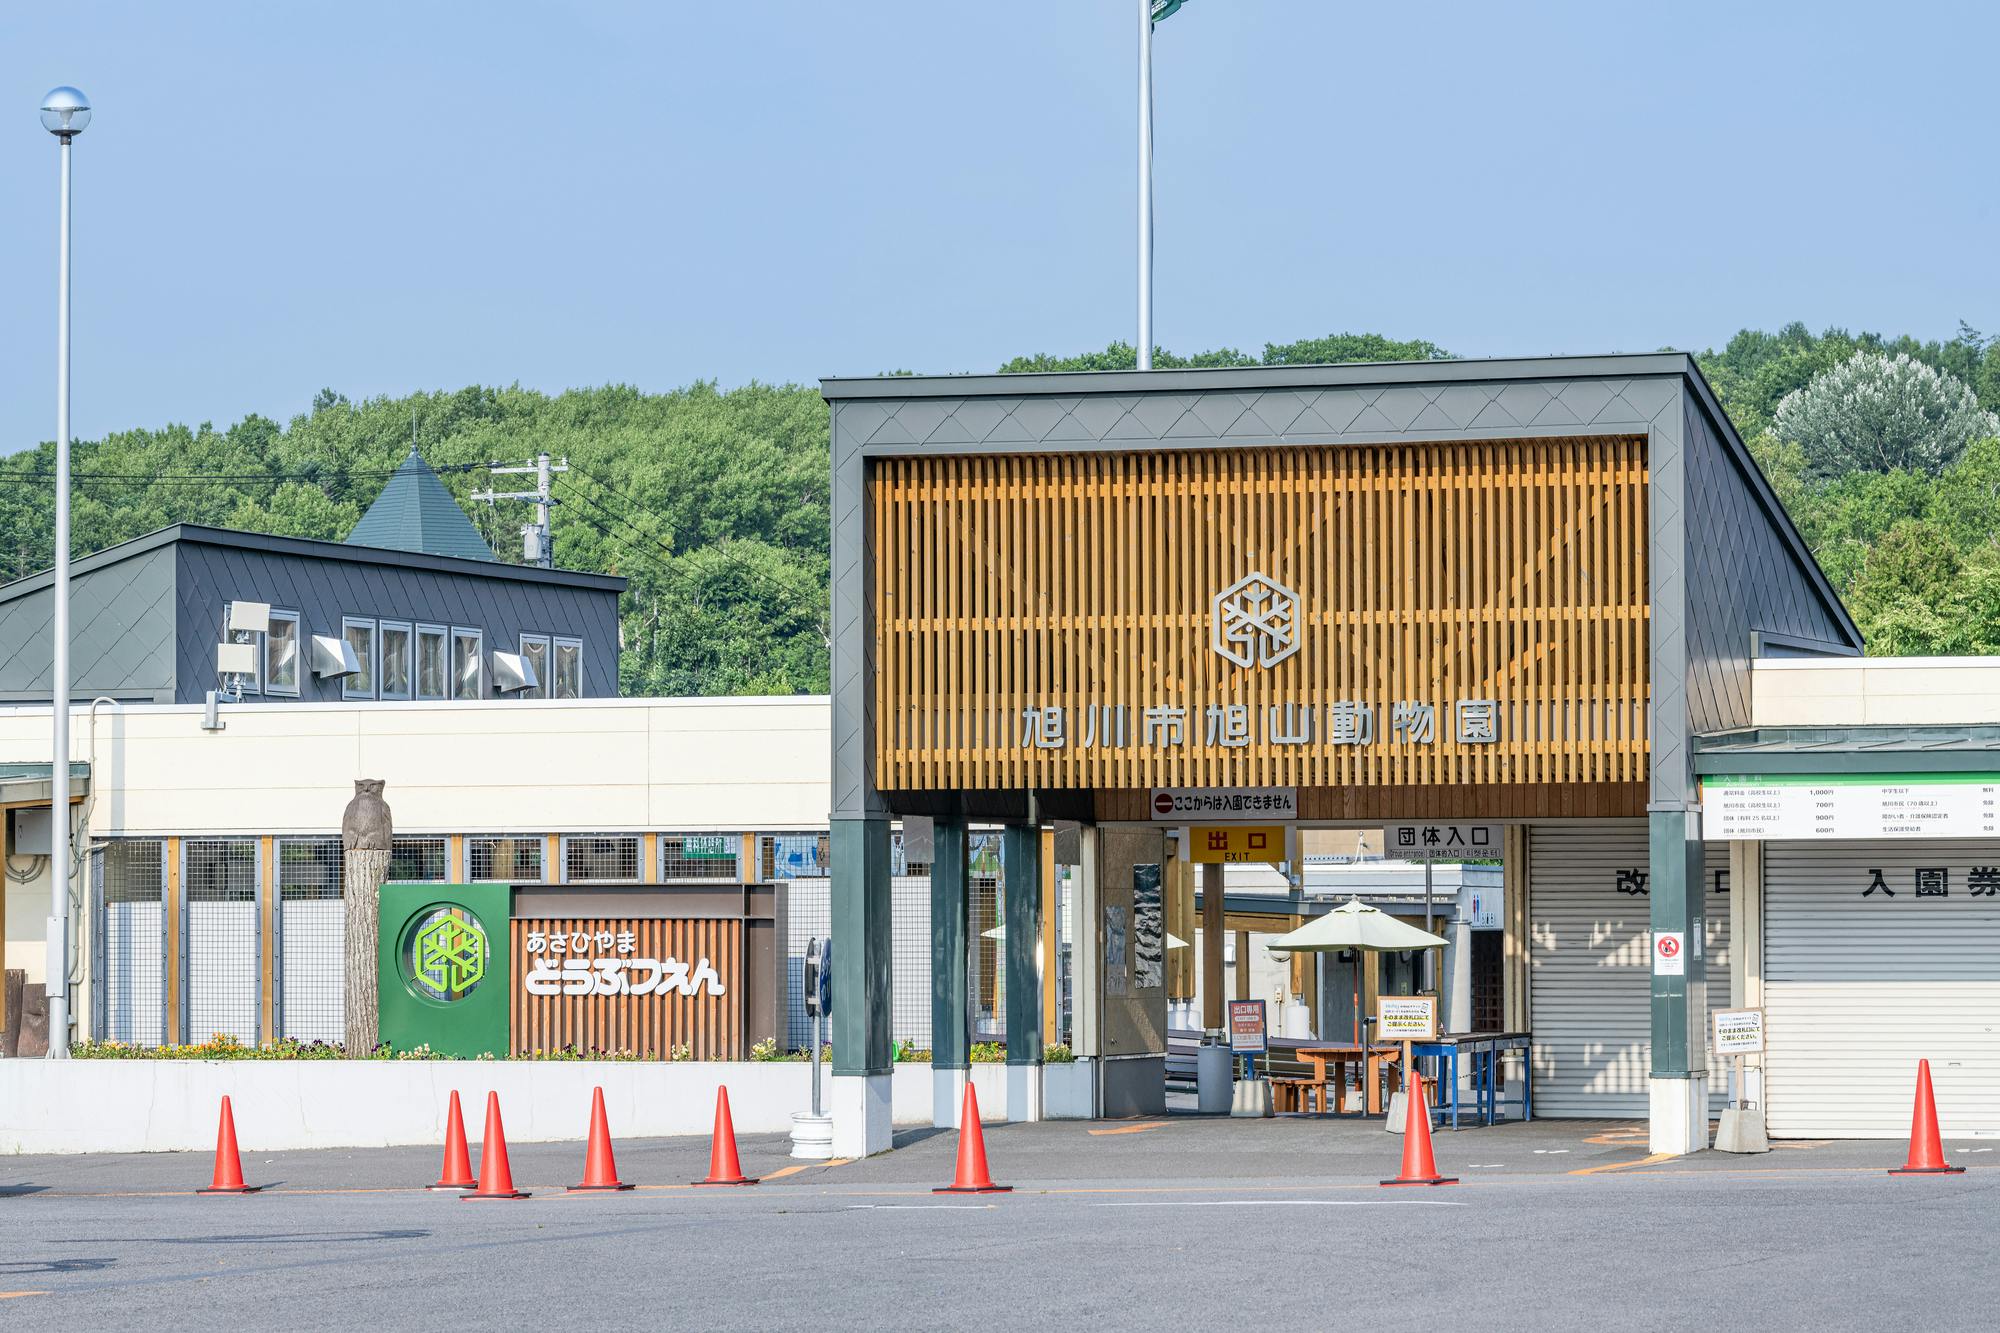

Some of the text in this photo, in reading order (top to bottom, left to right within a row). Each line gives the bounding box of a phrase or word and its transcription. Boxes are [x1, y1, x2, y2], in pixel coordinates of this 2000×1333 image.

[1021, 699, 1499, 749] 旭川市旭山動物園
[1174, 795, 1292, 811] ここからは入園できません
[1208, 831, 1267, 850] 出口
[1398, 826, 1489, 847] 団体入口
[1224, 852, 1250, 861] EXIT
[1862, 866, 2000, 898] 入園券
[526, 931, 636, 954] あさひやま
[525, 957, 726, 997] どうぶつえん
